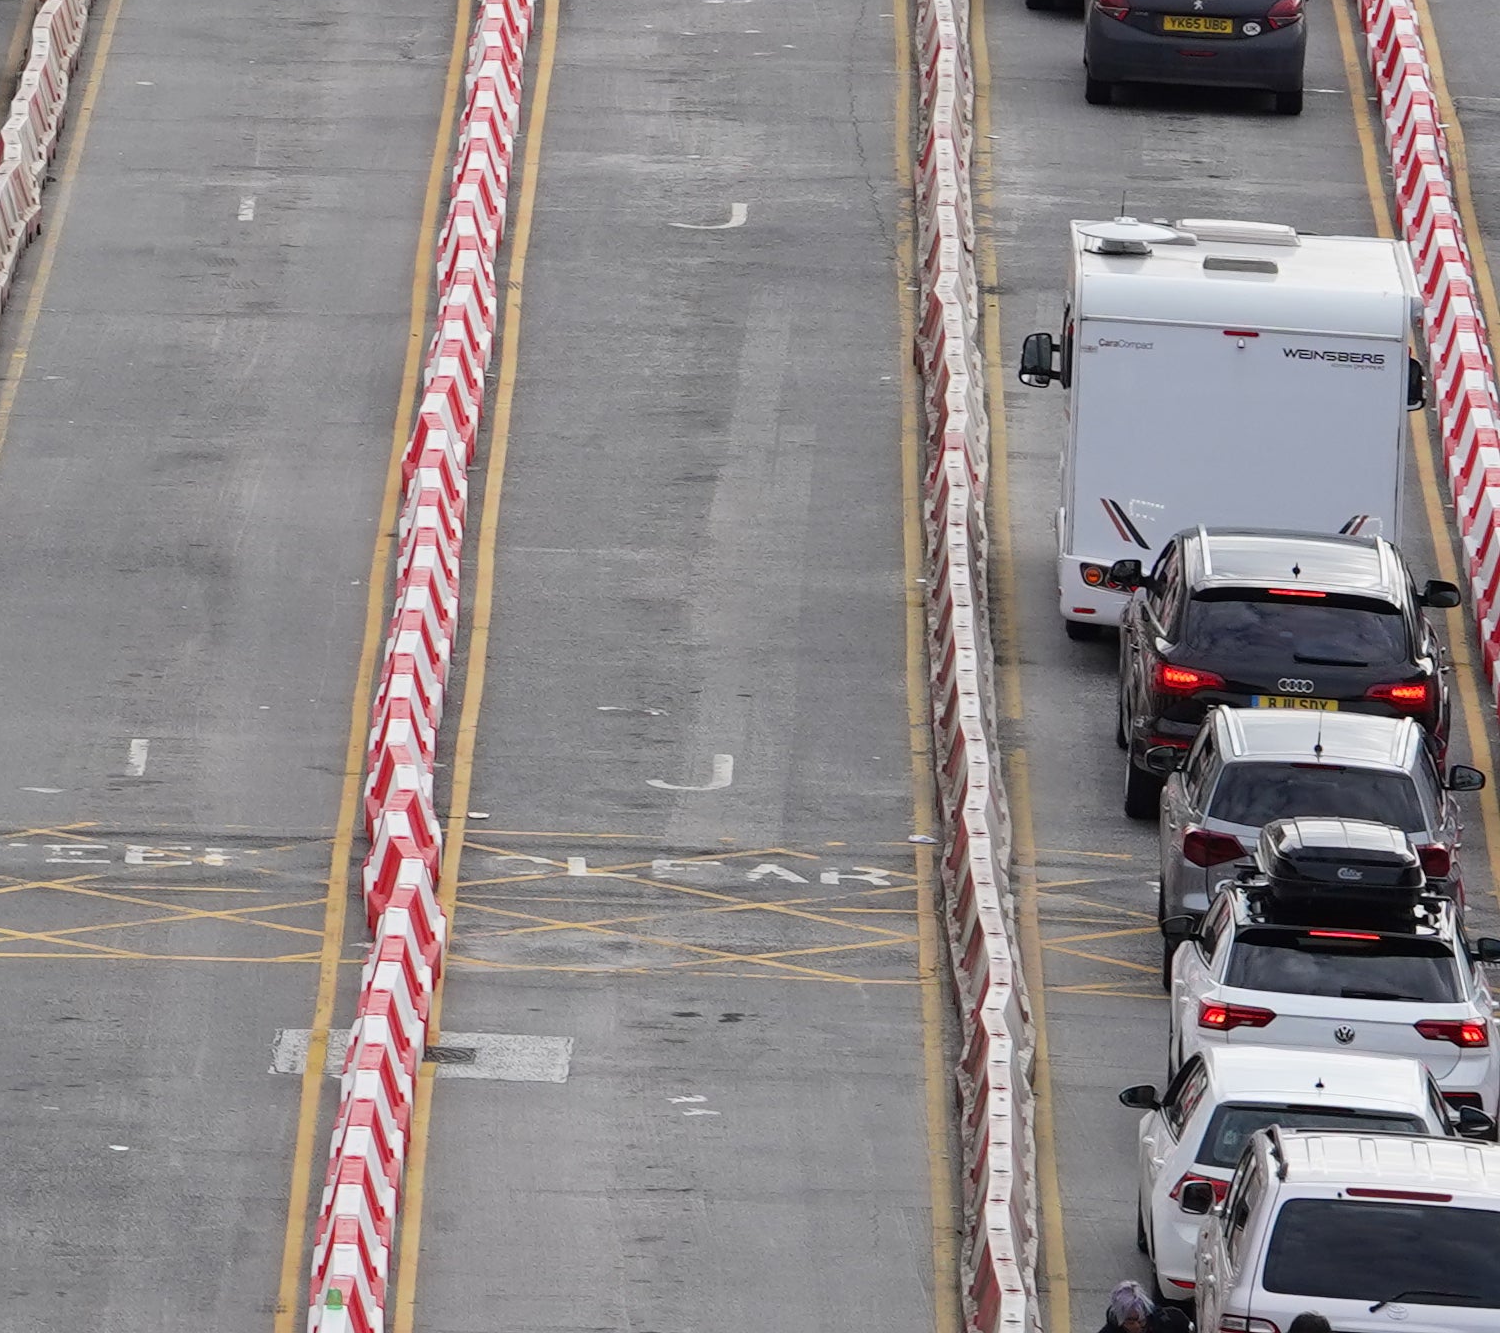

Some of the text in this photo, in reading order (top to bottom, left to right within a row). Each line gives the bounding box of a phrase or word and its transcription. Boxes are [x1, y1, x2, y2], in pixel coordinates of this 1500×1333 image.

[1169, 17, 1200, 30] YK65
[1245, 23, 1258, 33] UK
[1098, 338, 1155, 350] CaraCompact
[1282, 347, 1385, 365] WEINSBERG
